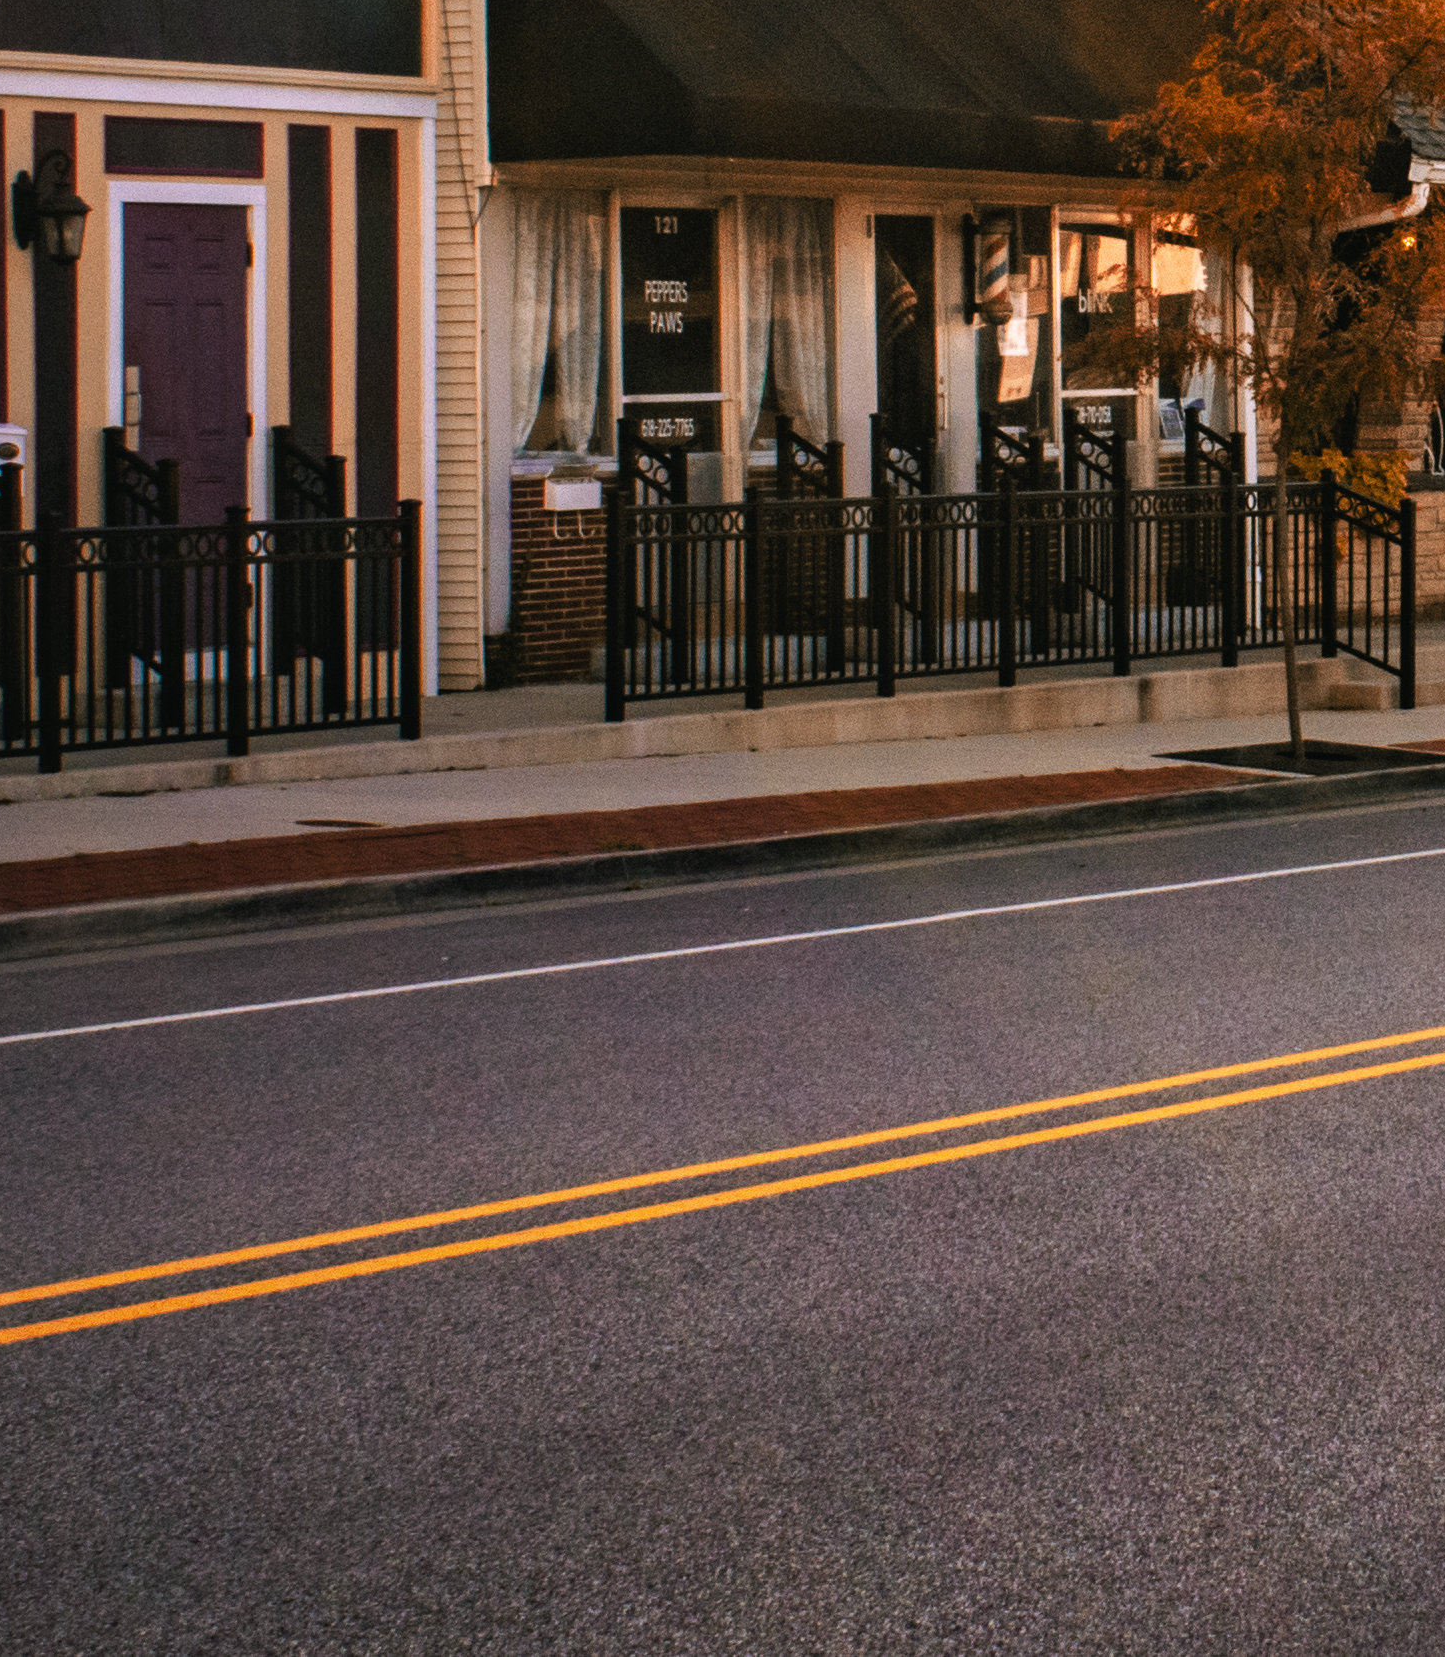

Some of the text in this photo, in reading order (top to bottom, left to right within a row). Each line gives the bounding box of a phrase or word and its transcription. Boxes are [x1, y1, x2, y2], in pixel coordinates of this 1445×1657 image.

[655, 216, 678, 234] 121
[645, 280, 688, 303] PEPPERS
[650, 311, 683, 333] PAWS
